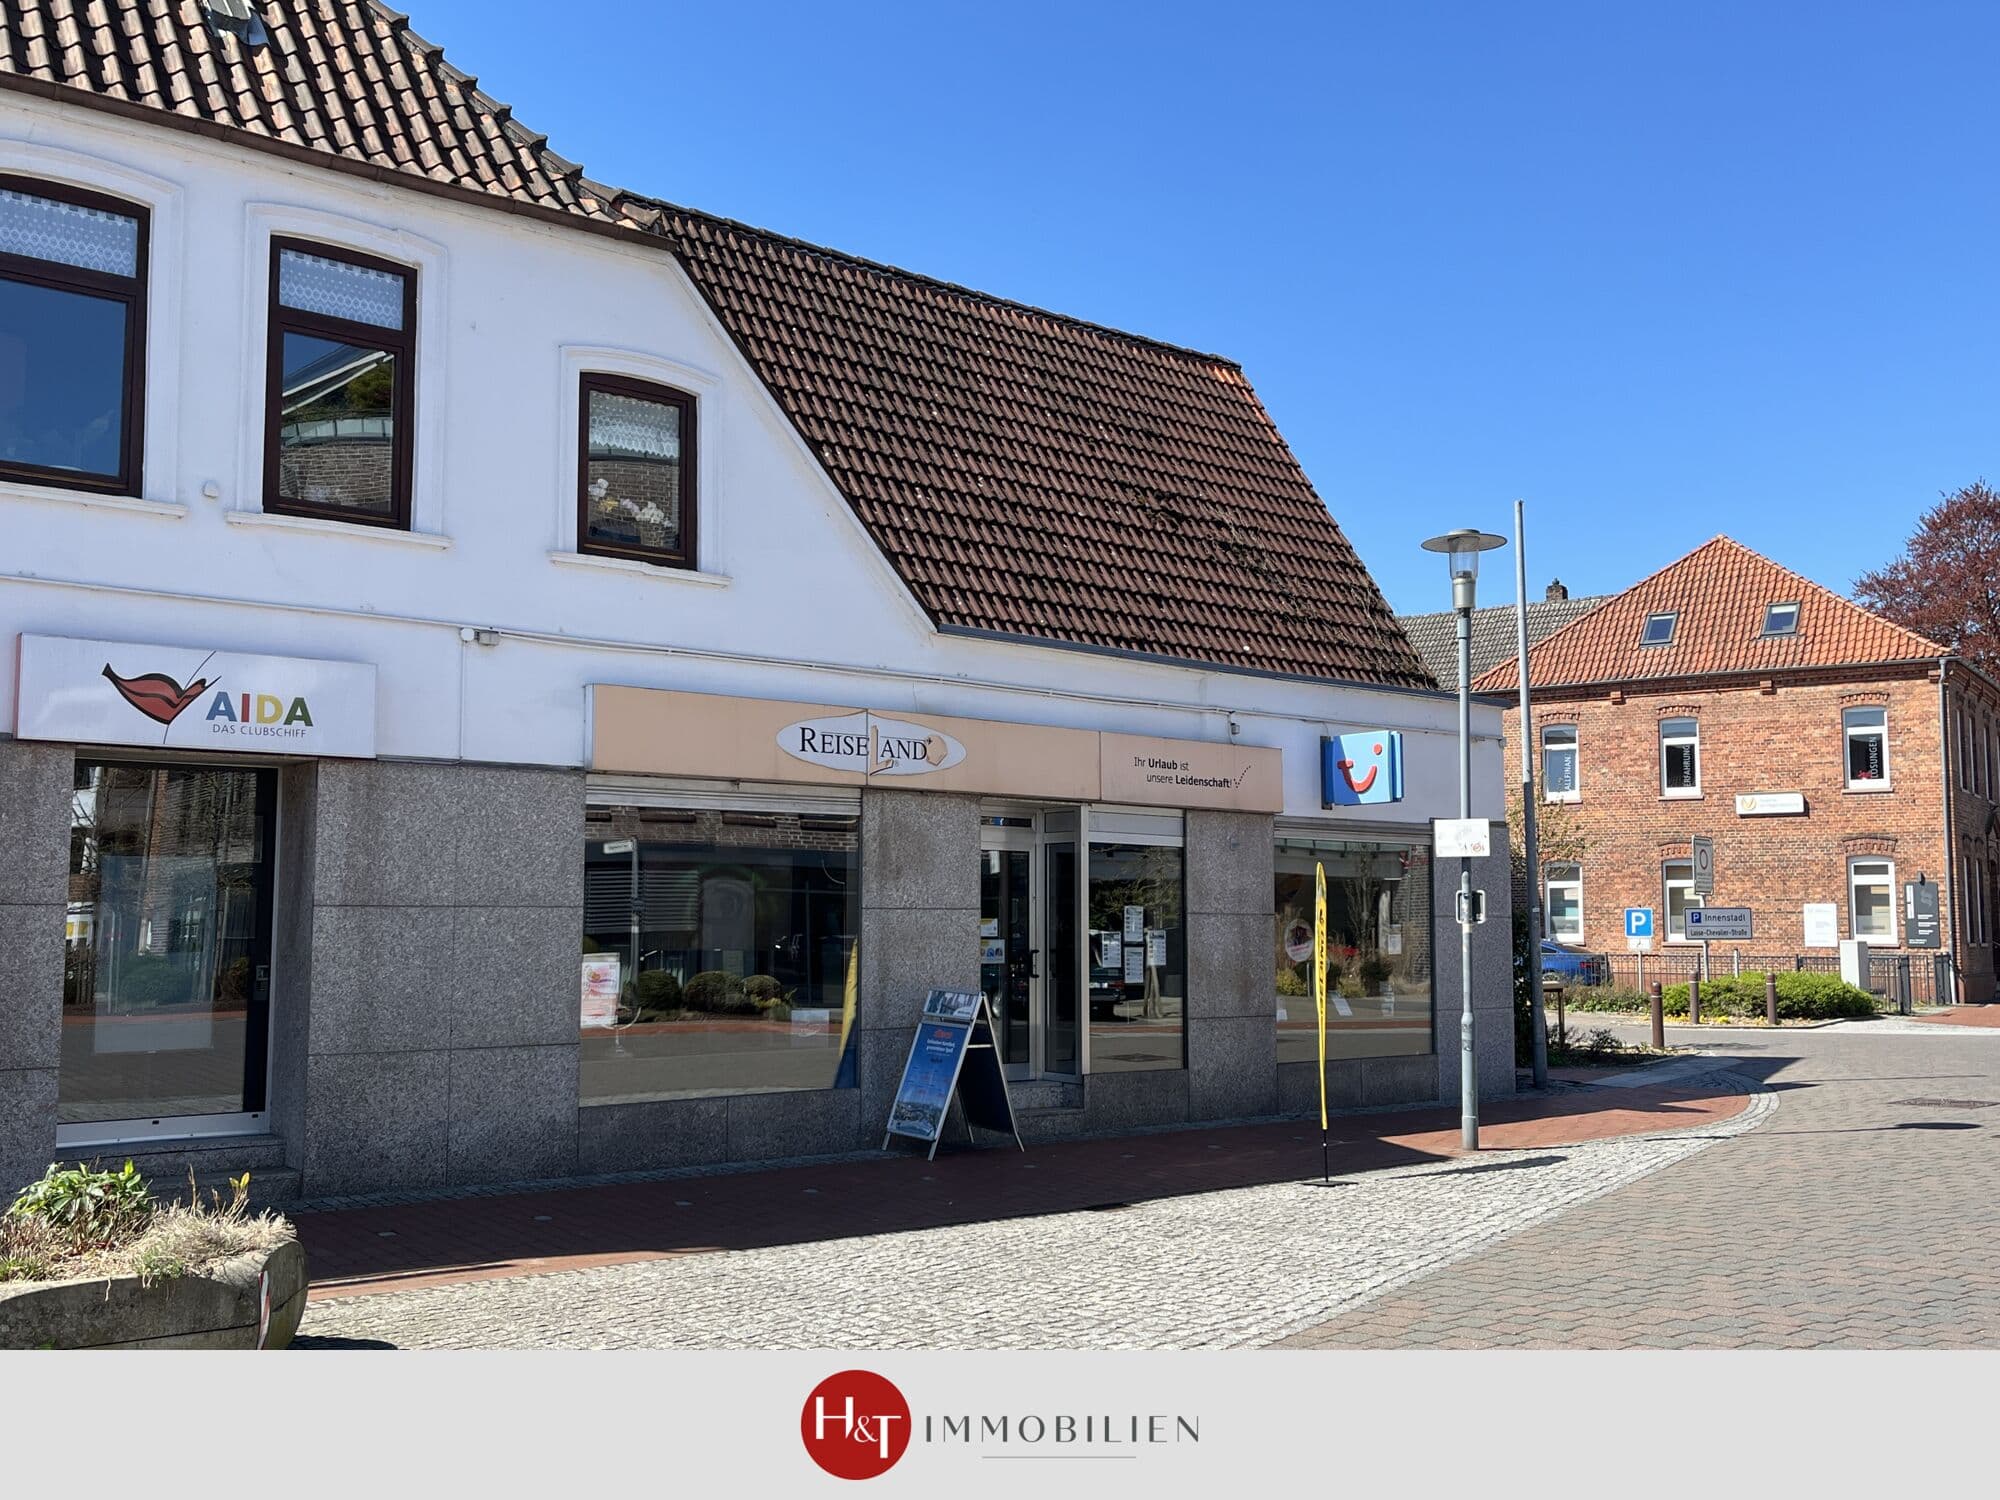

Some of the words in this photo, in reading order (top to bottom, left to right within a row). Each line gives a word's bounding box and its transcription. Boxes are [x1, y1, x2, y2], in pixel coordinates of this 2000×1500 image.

[205, 691, 314, 727] AIDA
[212, 723, 236, 735] DAS
[240, 726, 307, 738] CLUBSCHIFF
[1134, 756, 1146, 768] Ihr
[1148, 758, 1178, 770] Urlaub
[1180, 761, 1189, 771] ist
[1563, 752, 1571, 791] ALLFINAN
[1146, 773, 1174, 785] unsere
[1631, 911, 1646, 934] P
